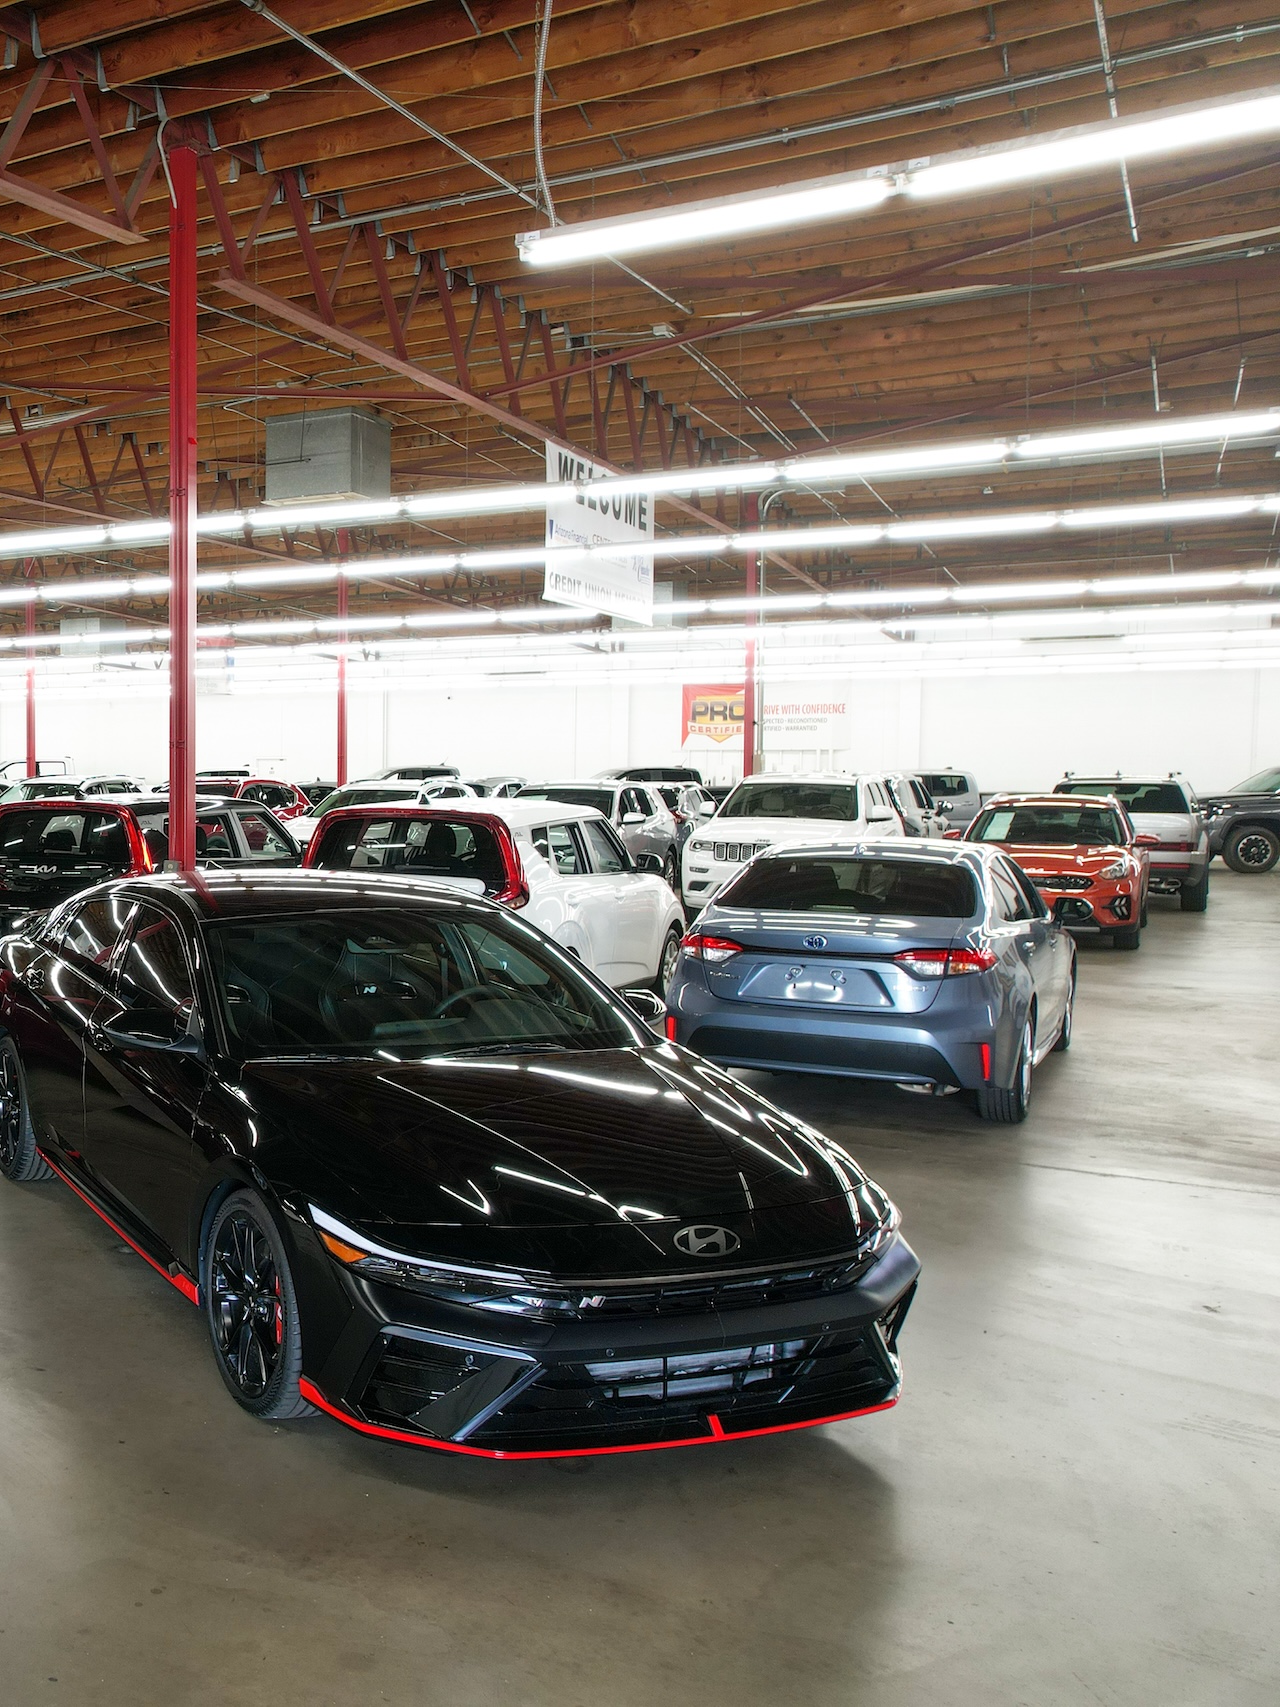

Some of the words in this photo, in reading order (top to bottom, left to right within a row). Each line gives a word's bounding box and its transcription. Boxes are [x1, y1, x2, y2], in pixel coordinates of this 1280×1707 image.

[549, 571, 582, 597] CREDIT
[584, 581, 612, 604] UNION
[764, 704, 780, 715] RIVE
[781, 704, 800, 715] WITH
[801, 703, 846, 714] CONFIDENCE
[689, 725, 742, 735] CERTIFIE
